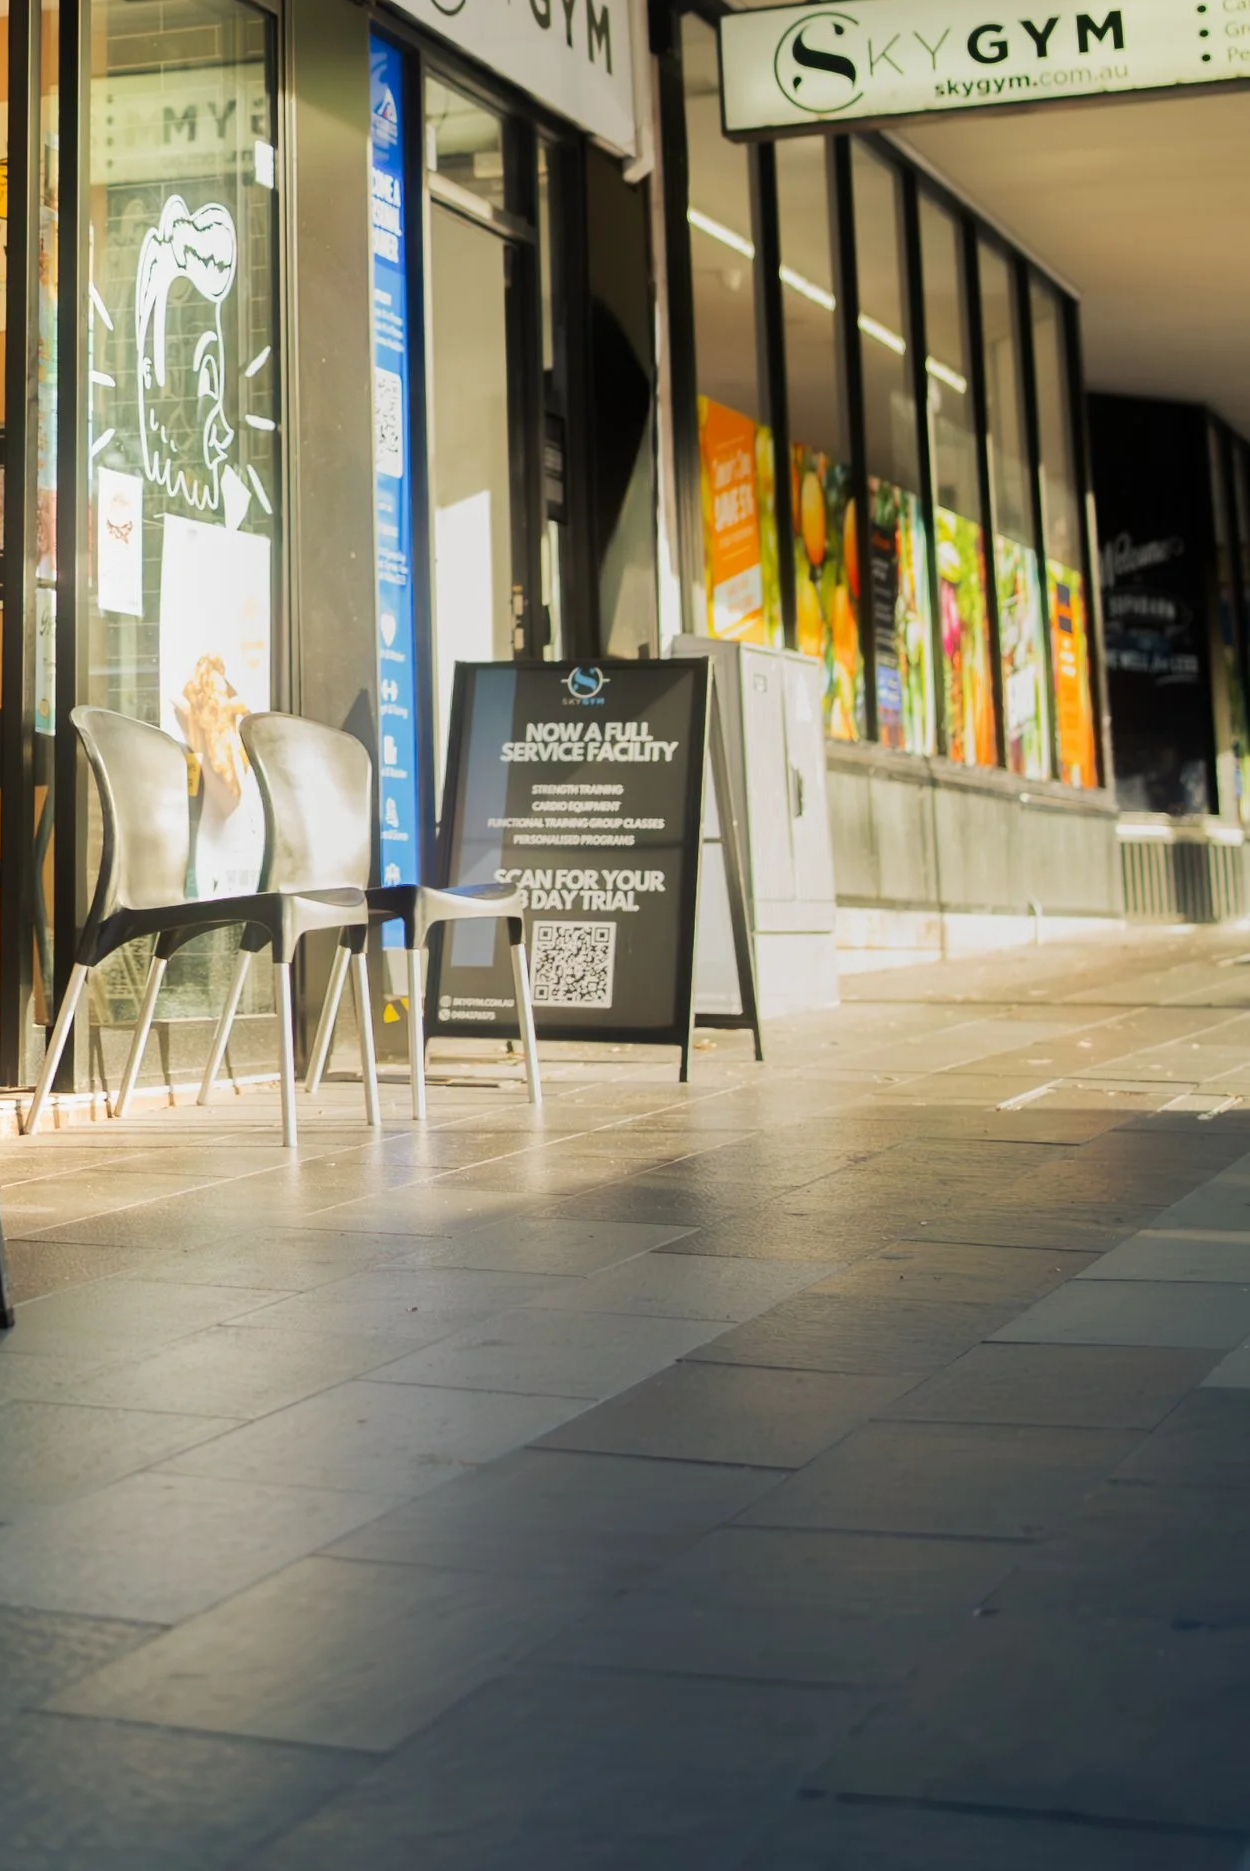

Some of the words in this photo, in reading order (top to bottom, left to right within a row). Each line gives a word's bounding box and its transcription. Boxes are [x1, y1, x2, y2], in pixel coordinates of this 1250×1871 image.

[934, 63, 1130, 100] skygym.com.au
[526, 722, 584, 742] NOW
[583, 722, 603, 742] A
[604, 722, 655, 742] FULL
[500, 742, 586, 763] SERVICE
[586, 741, 680, 763] FACILITY
[493, 869, 553, 891] SCAN
[554, 869, 600, 891] FOR
[601, 870, 667, 892] YOUR
[532, 890, 578, 911] DAY
[579, 891, 641, 912] TRIAL
